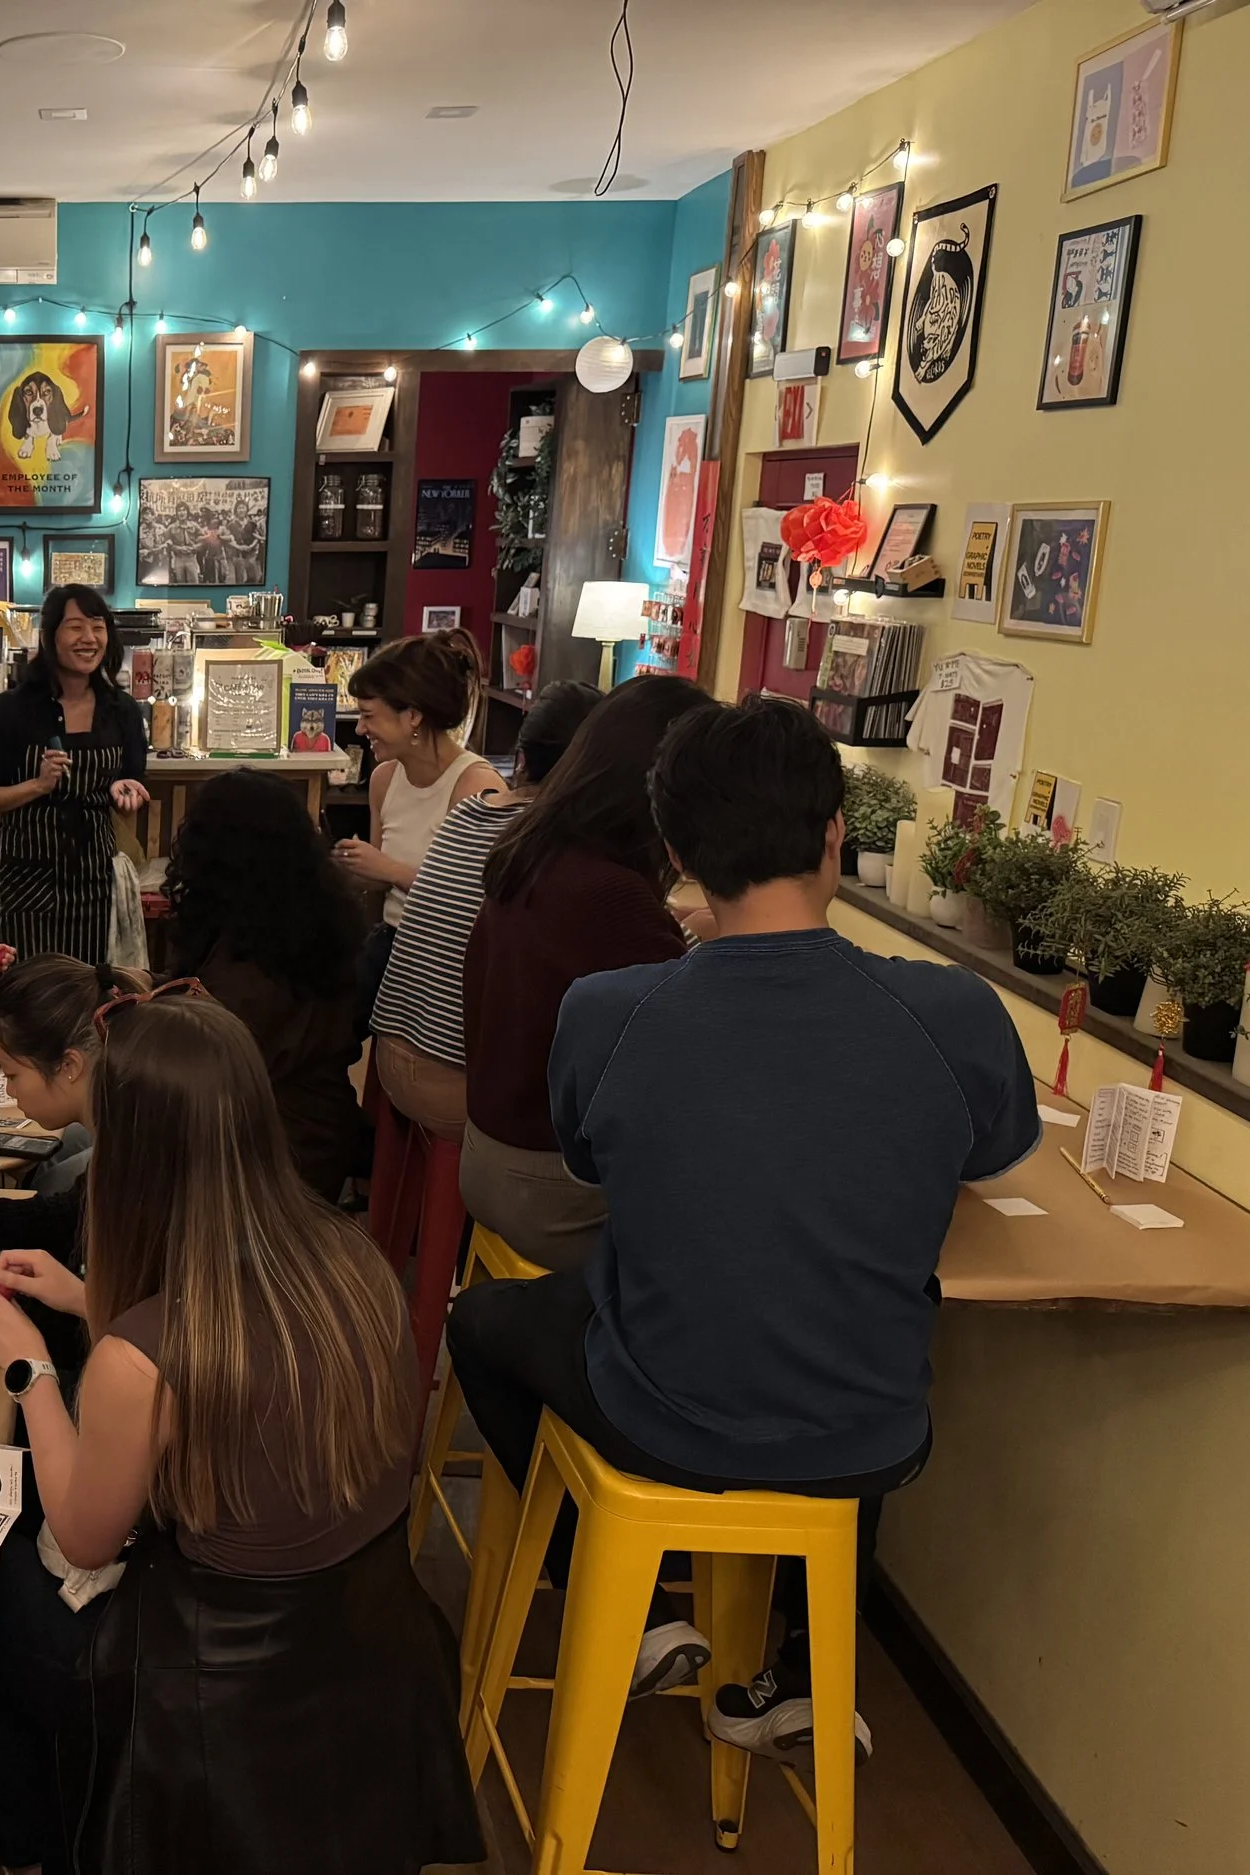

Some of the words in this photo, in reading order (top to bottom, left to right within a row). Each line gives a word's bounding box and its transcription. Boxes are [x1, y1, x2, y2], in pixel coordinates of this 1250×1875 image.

[2, 473, 61, 482] EMPLOYEE
[63, 473, 78, 482] OF
[8, 484, 29, 493] THE
[31, 484, 72, 493] MONTH
[972, 532, 992, 541] POETRY
[965, 551, 988, 561] GRAPHIC
[967, 562, 986, 571] NOVELS
[933, 662, 943, 672] YU
[951, 659, 960, 669] ME
[940, 679, 954, 689] $25
